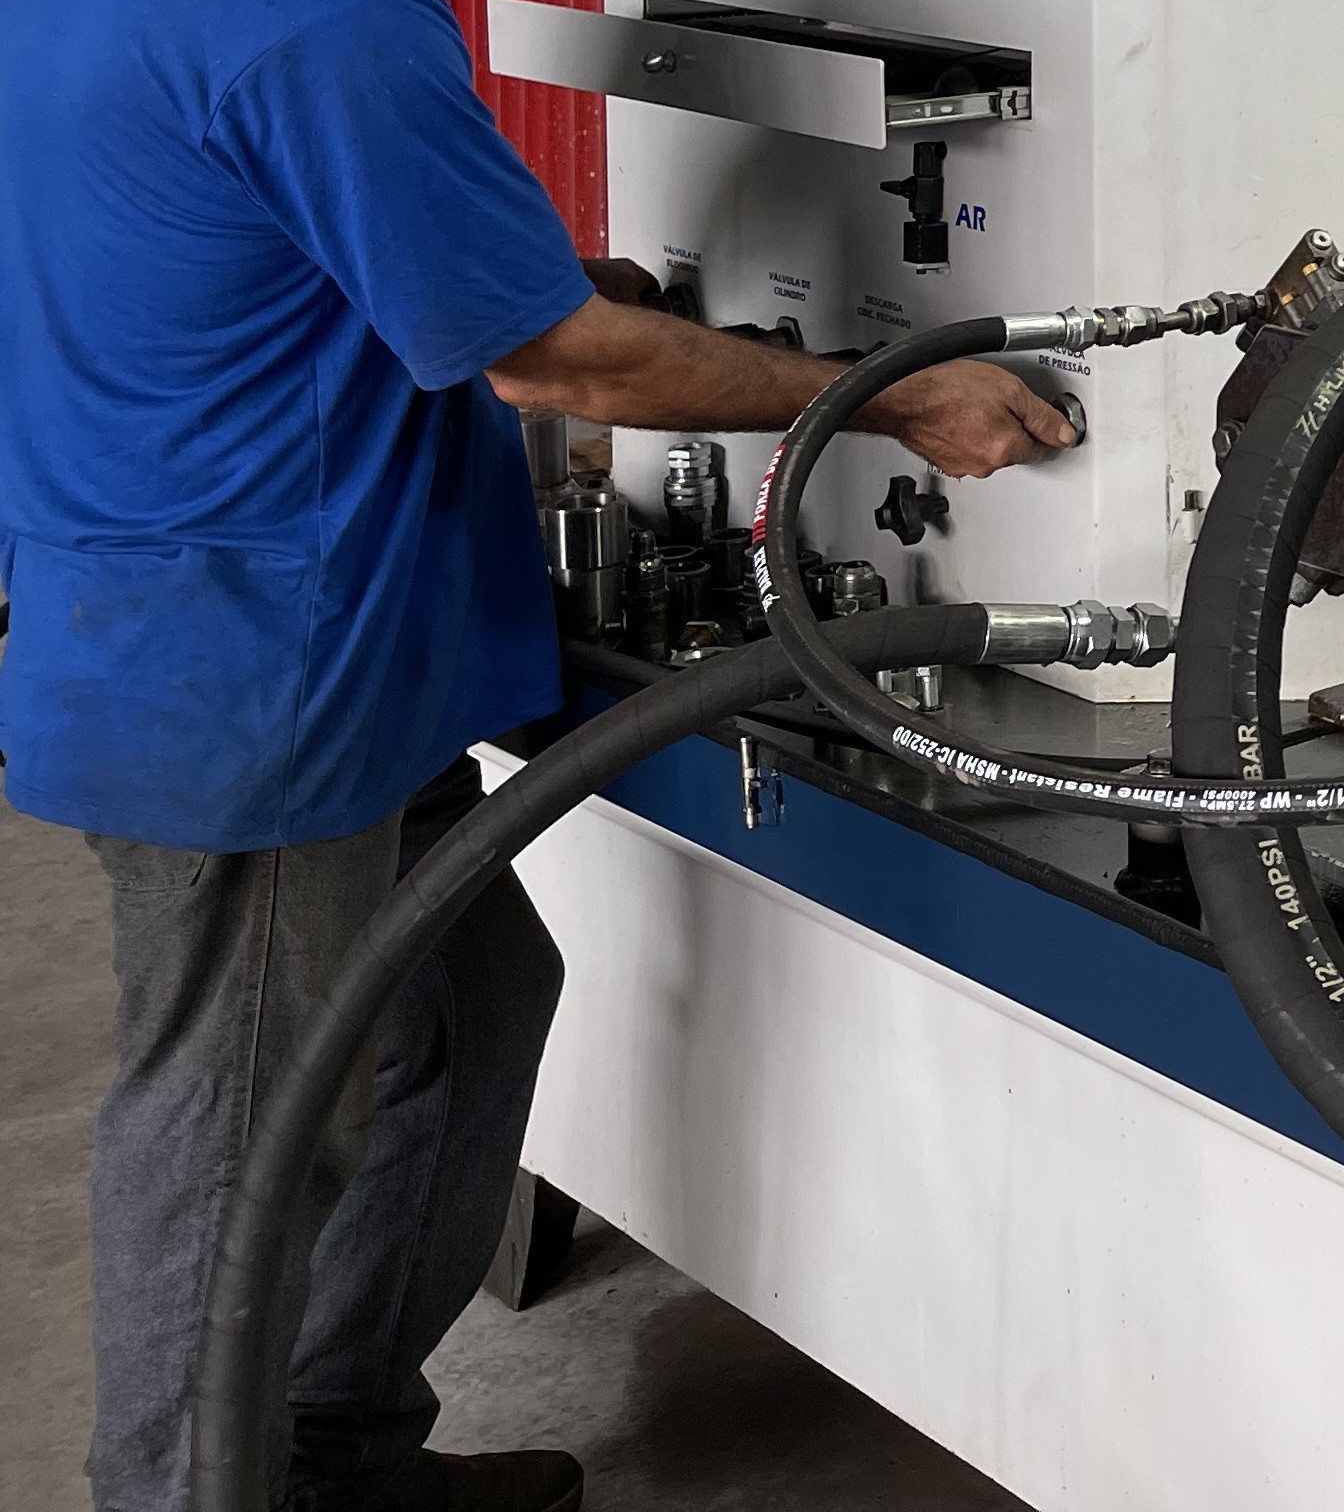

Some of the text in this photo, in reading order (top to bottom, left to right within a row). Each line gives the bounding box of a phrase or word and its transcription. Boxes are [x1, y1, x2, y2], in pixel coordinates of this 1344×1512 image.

[956, 203, 986, 232] AR
[1039, 355, 1090, 376] DE PRESSÃO
[956, 751, 1001, 781] MSHA
[1008, 767, 1112, 798] Resistant
[1118, 786, 1185, 807] Flame
[1203, 790, 1256, 801] 4000PSI
[1260, 791, 1291, 808] WP
[1258, 838, 1308, 931] 140PSI
